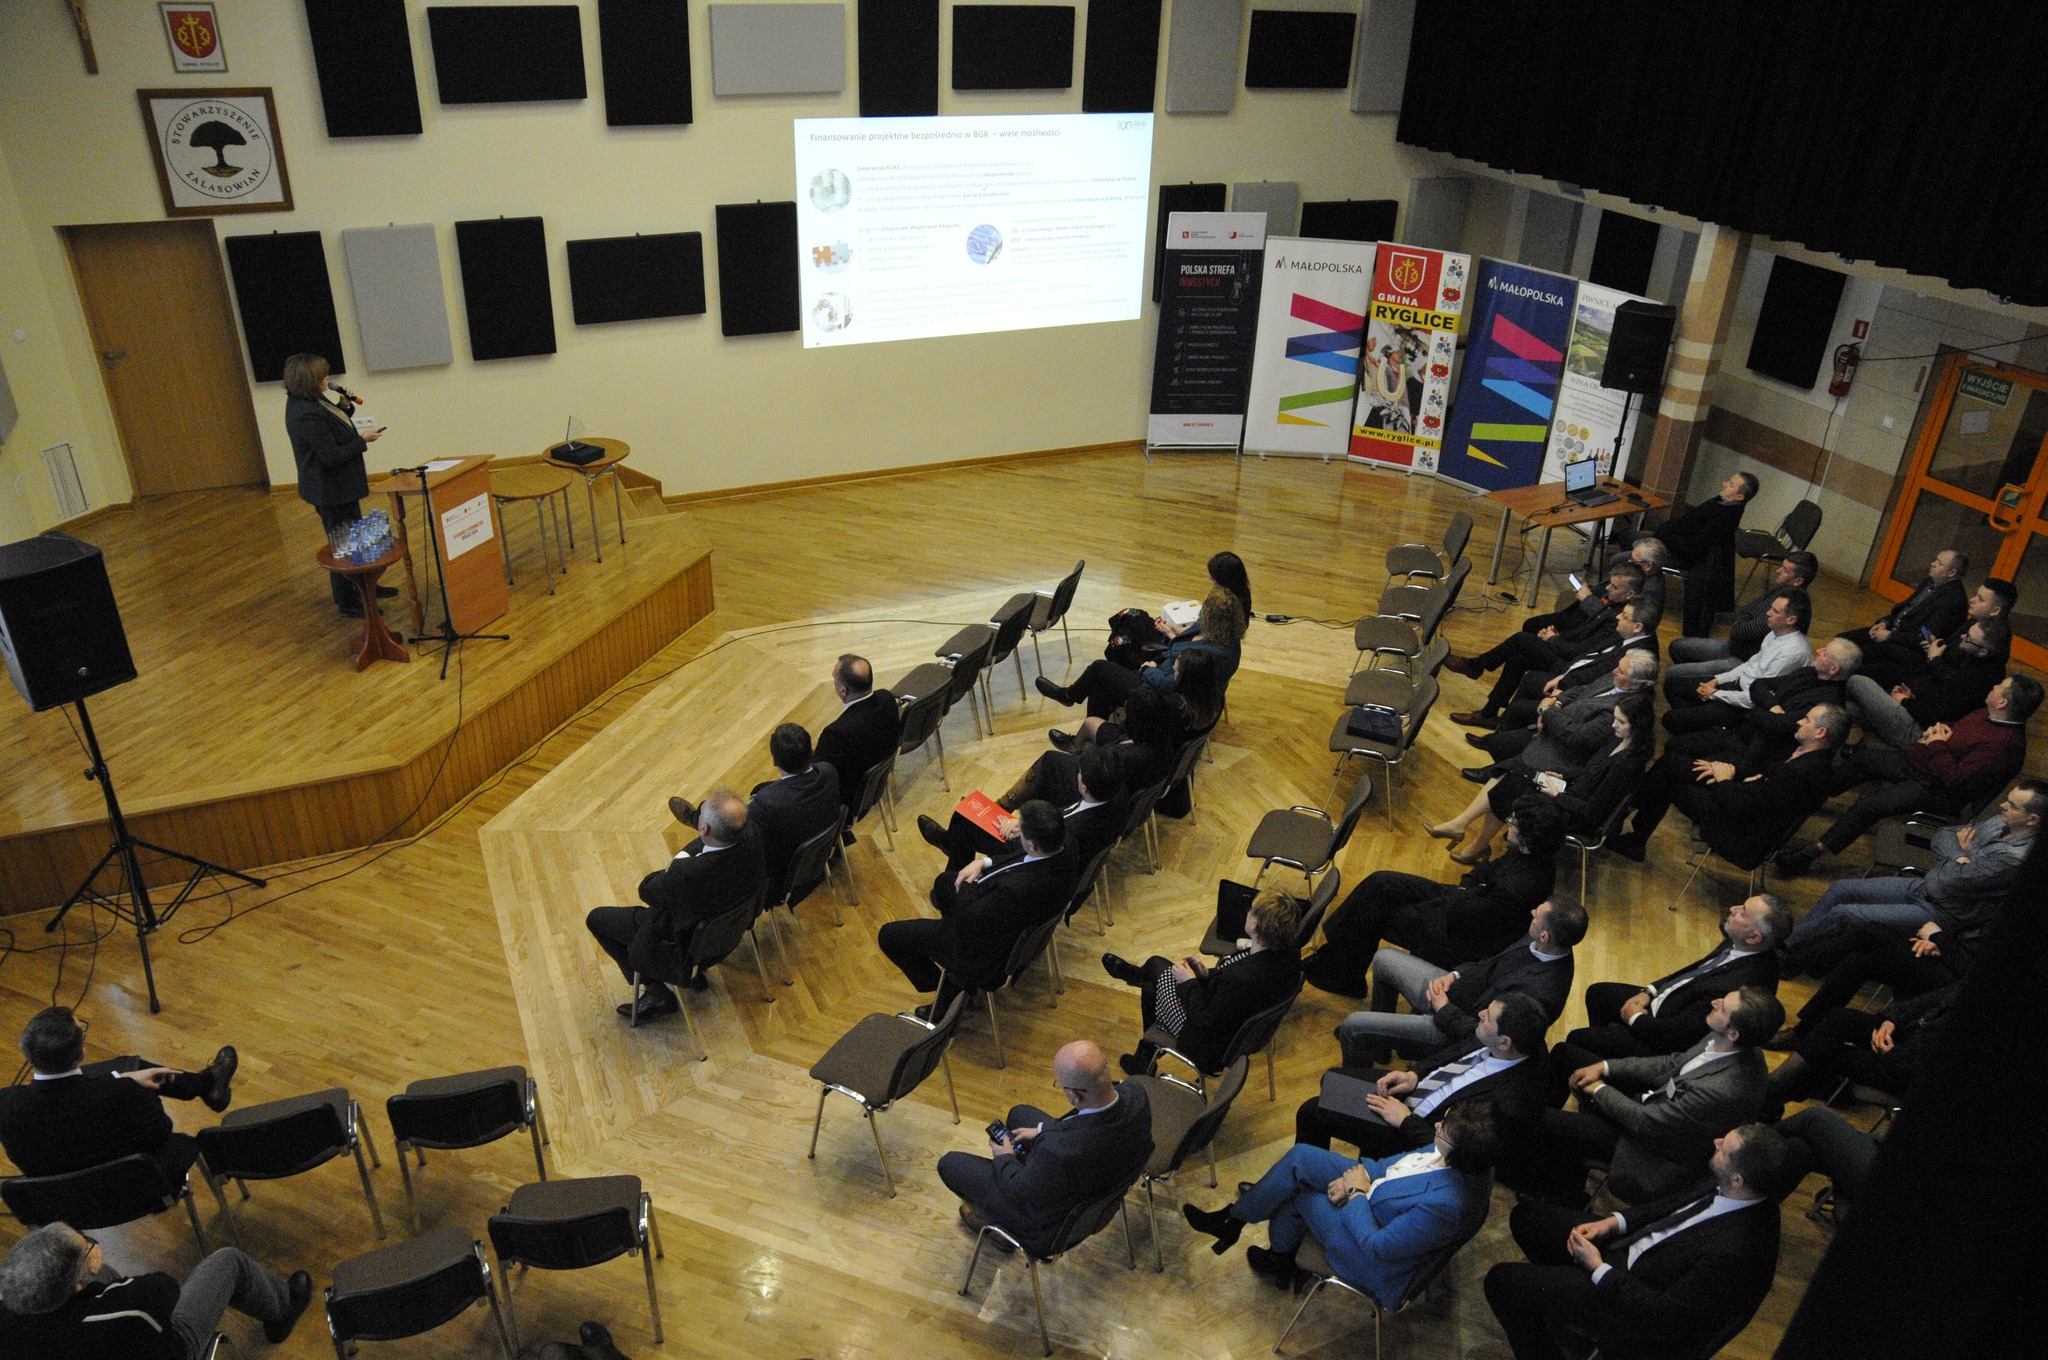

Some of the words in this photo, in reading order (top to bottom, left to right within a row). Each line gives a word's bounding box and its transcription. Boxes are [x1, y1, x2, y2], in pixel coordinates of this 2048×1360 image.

[172, 106, 260, 145] STOWARZYSZENIE
[810, 132, 866, 142] Finansowanie
[868, 132, 909, 142] projektów
[911, 130, 962, 140] bezpośrednio
[1000, 129, 1018, 138] wiele
[1020, 128, 1060, 137] możliwości
[186, 168, 260, 193] ZALASOWIAN
[1180, 264, 1208, 275] POLSKA
[1208, 264, 1235, 275] STREFA
[1290, 260, 1363, 274] MAŁOPOLSKA
[1378, 292, 1418, 307] GMINA
[1500, 284, 1564, 307] MAŁOPOLSKA
[1582, 294, 1610, 308] PIWNICE
[1376, 304, 1455, 330] RYGLICE
[1570, 376, 1588, 388] WINA
[1967, 374, 2009, 393] WYJŚCIE
[1360, 428, 1434, 447] www.ryglice.pl
